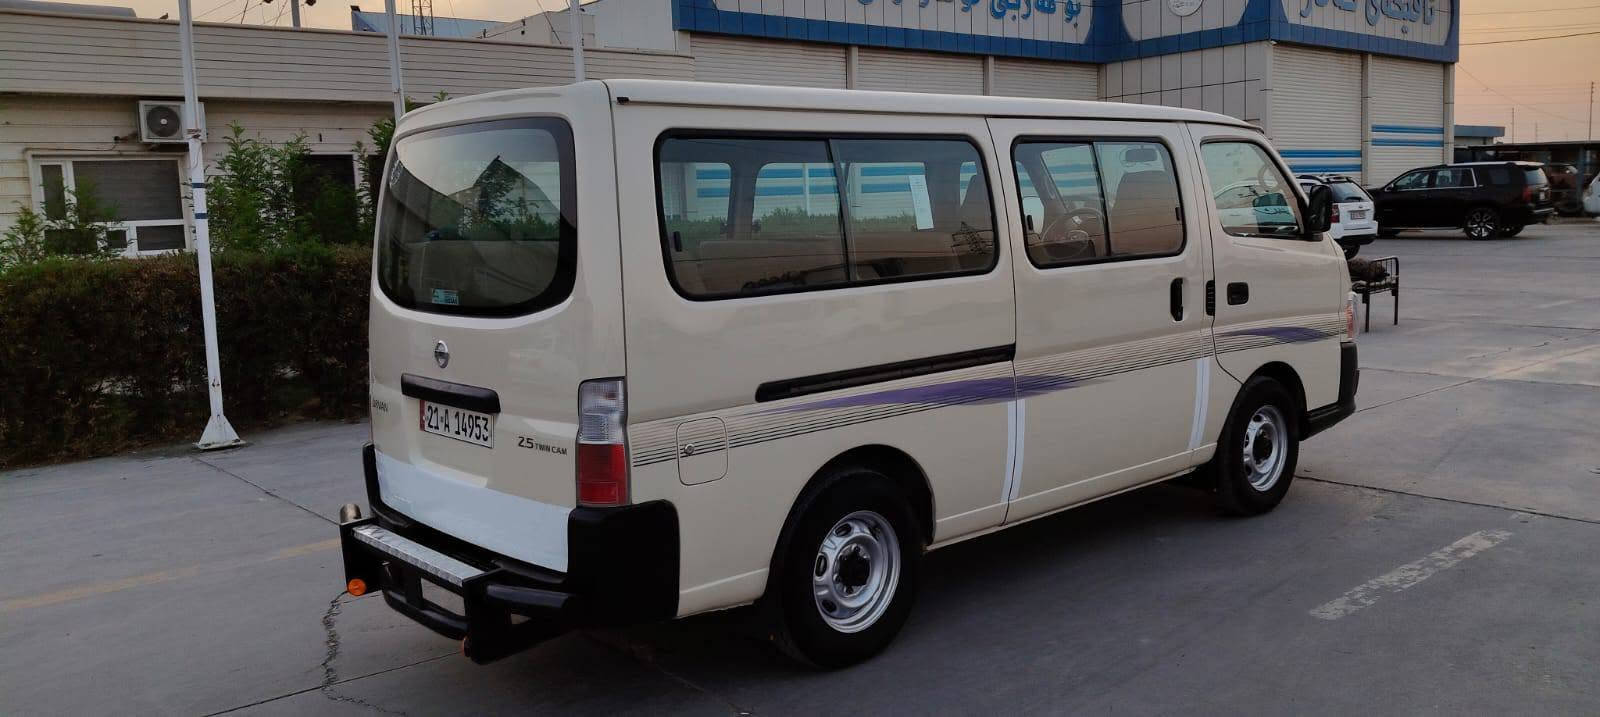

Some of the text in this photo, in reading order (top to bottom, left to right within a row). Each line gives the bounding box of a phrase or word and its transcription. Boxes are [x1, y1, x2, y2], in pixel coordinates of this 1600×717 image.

[454, 411, 489, 442] 14953
[518, 436, 568, 456] 2.5 TWIN CAM
